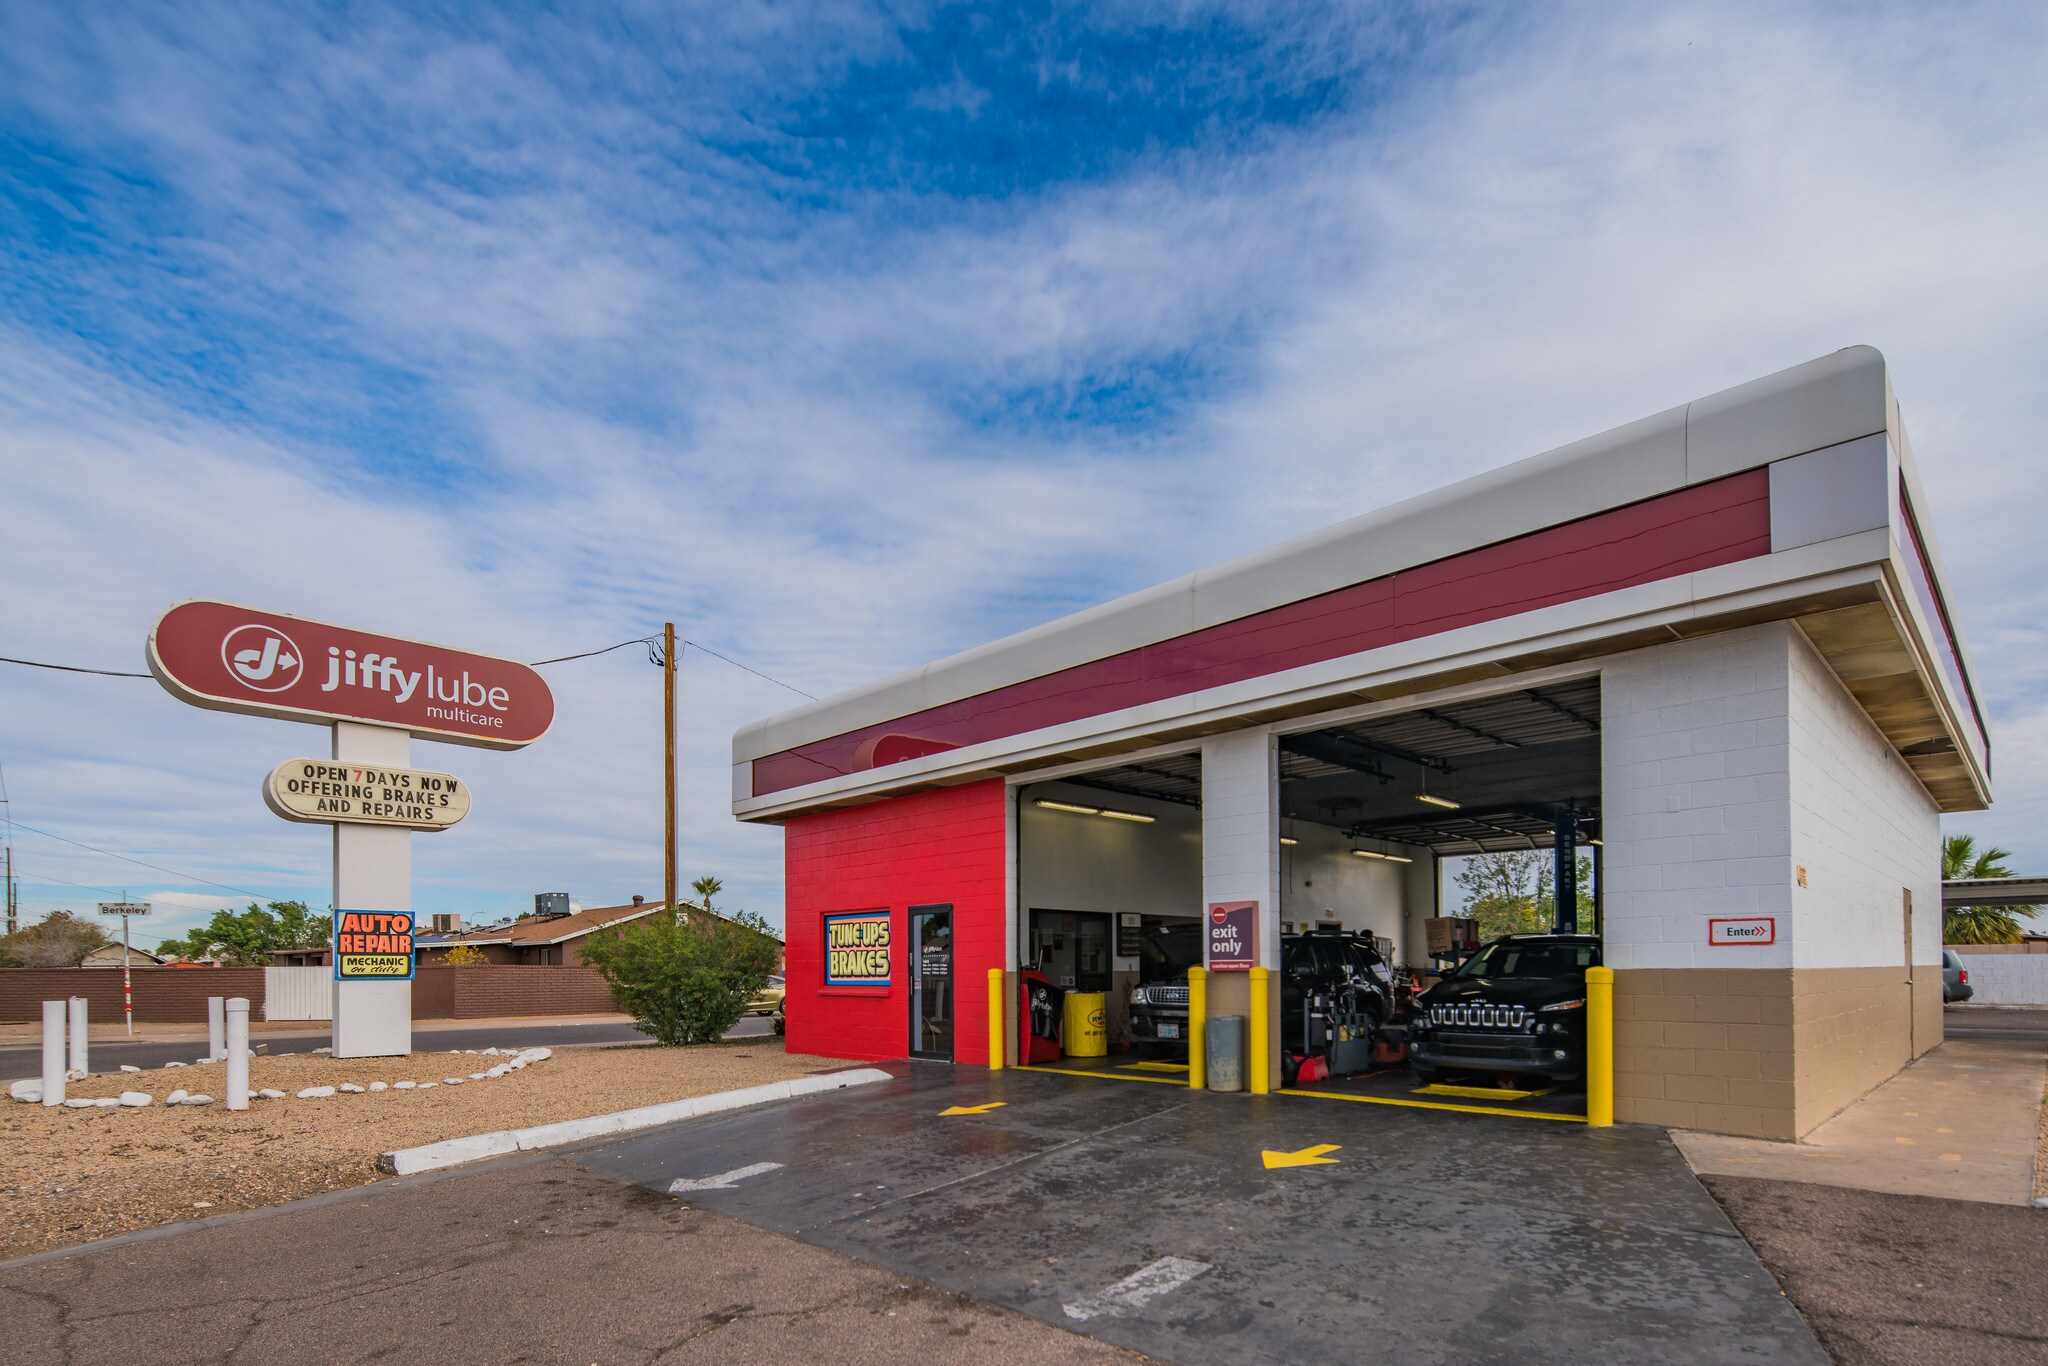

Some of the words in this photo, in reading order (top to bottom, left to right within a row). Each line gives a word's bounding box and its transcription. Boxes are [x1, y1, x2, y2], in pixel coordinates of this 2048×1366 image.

[321, 647, 422, 703] jiffy
[427, 665, 510, 711] lube
[427, 706, 503, 728] multicare
[304, 765, 348, 782] OPEN
[353, 770, 363, 783] 7
[366, 771, 410, 787] DAYS
[421, 777, 458, 793] NOW
[287, 779, 373, 799] OFFERING
[383, 788, 449, 807] BRAKES
[317, 798, 351, 813] AND
[362, 802, 434, 820] REPAIRS
[102, 906, 147, 915] Berkeley
[342, 913, 411, 933] AUTO
[1212, 924, 1238, 939] exit
[1726, 927, 1755, 936] Enter
[339, 934, 412, 953] REPAIR
[1212, 938, 1242, 956] only
[347, 957, 404, 966] MECHANIC
[370, 965, 400, 974] duty
[830, 949, 890, 977] BRAKES
